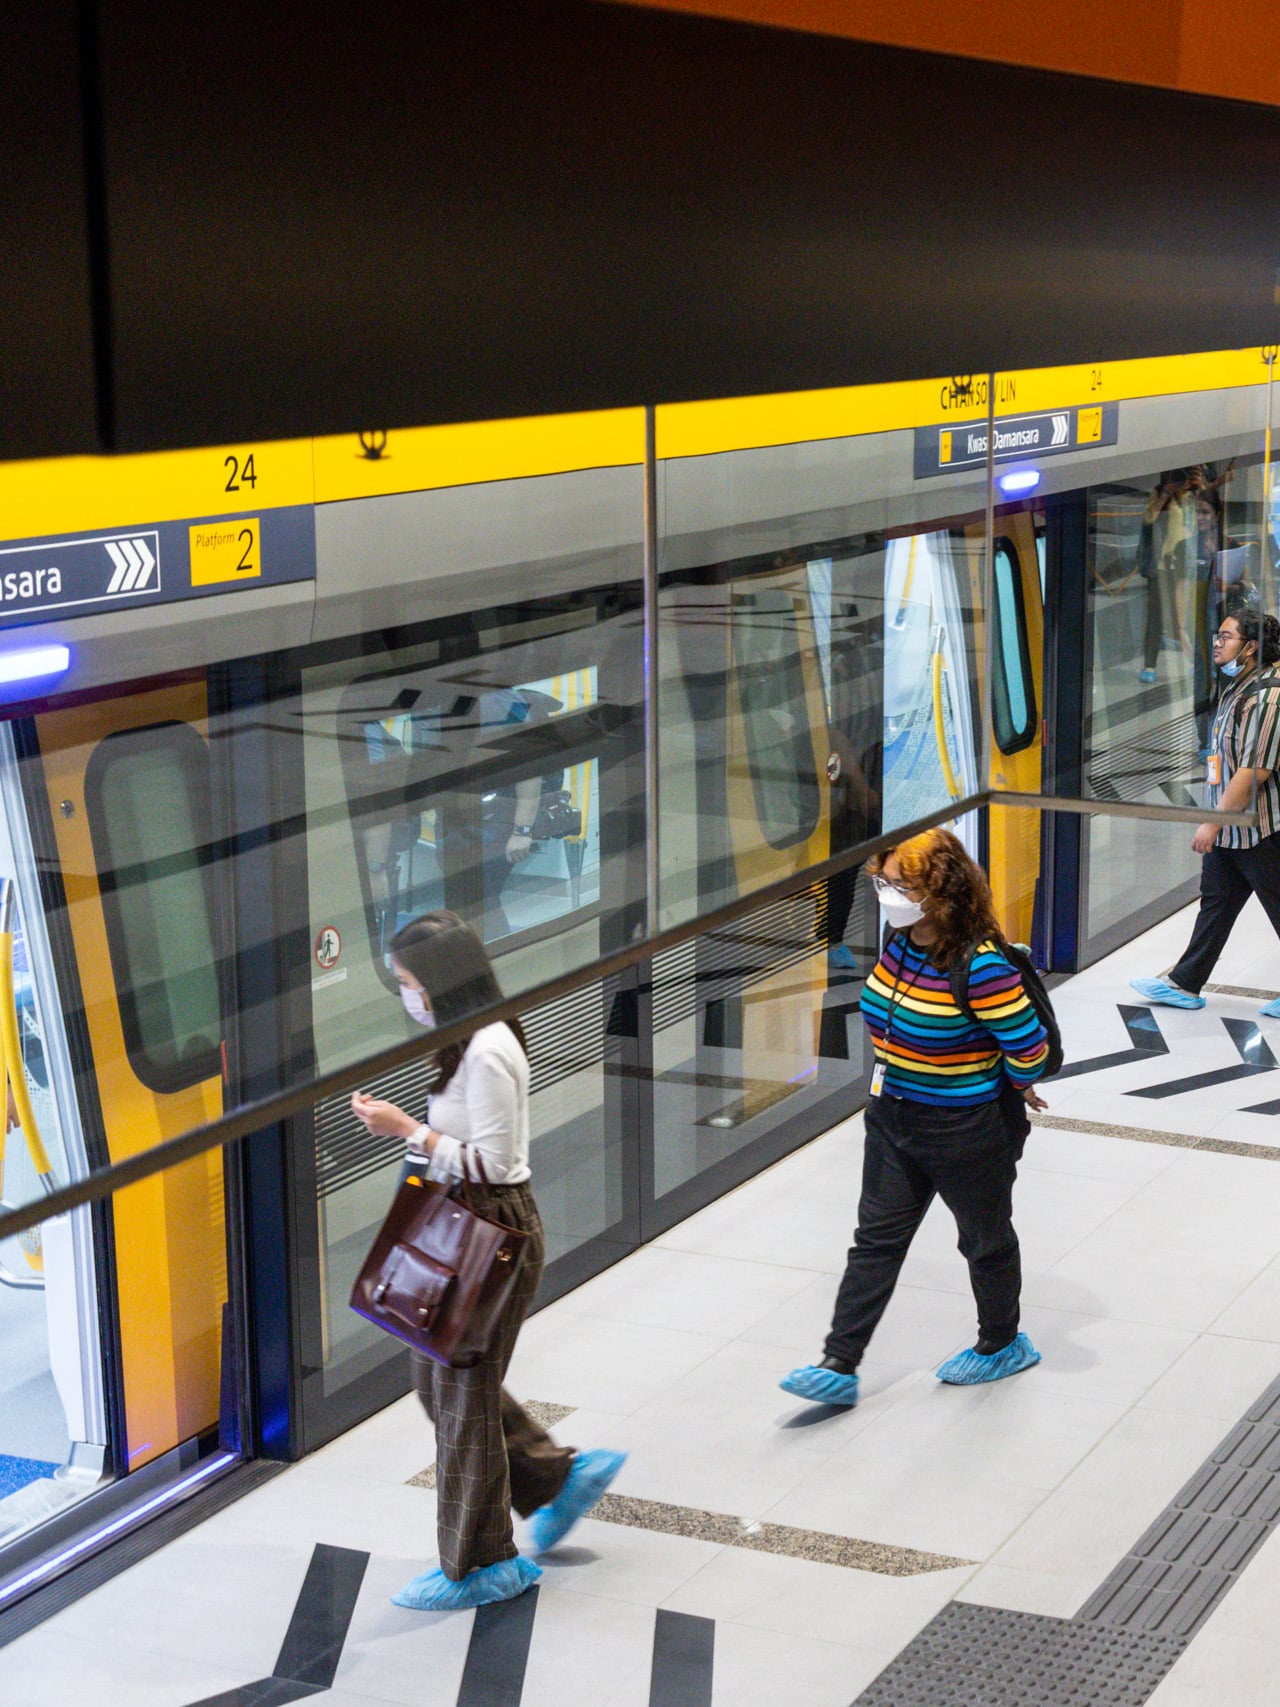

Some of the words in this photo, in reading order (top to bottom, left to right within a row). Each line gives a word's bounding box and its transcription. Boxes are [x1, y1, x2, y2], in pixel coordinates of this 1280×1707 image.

[967, 433, 989, 455] Kwas
[992, 428, 1040, 450] Damansara
[224, 453, 258, 492] 24
[195, 531, 235, 550] Platform
[236, 528, 253, 571] 2
[0, 567, 62, 601] sara
